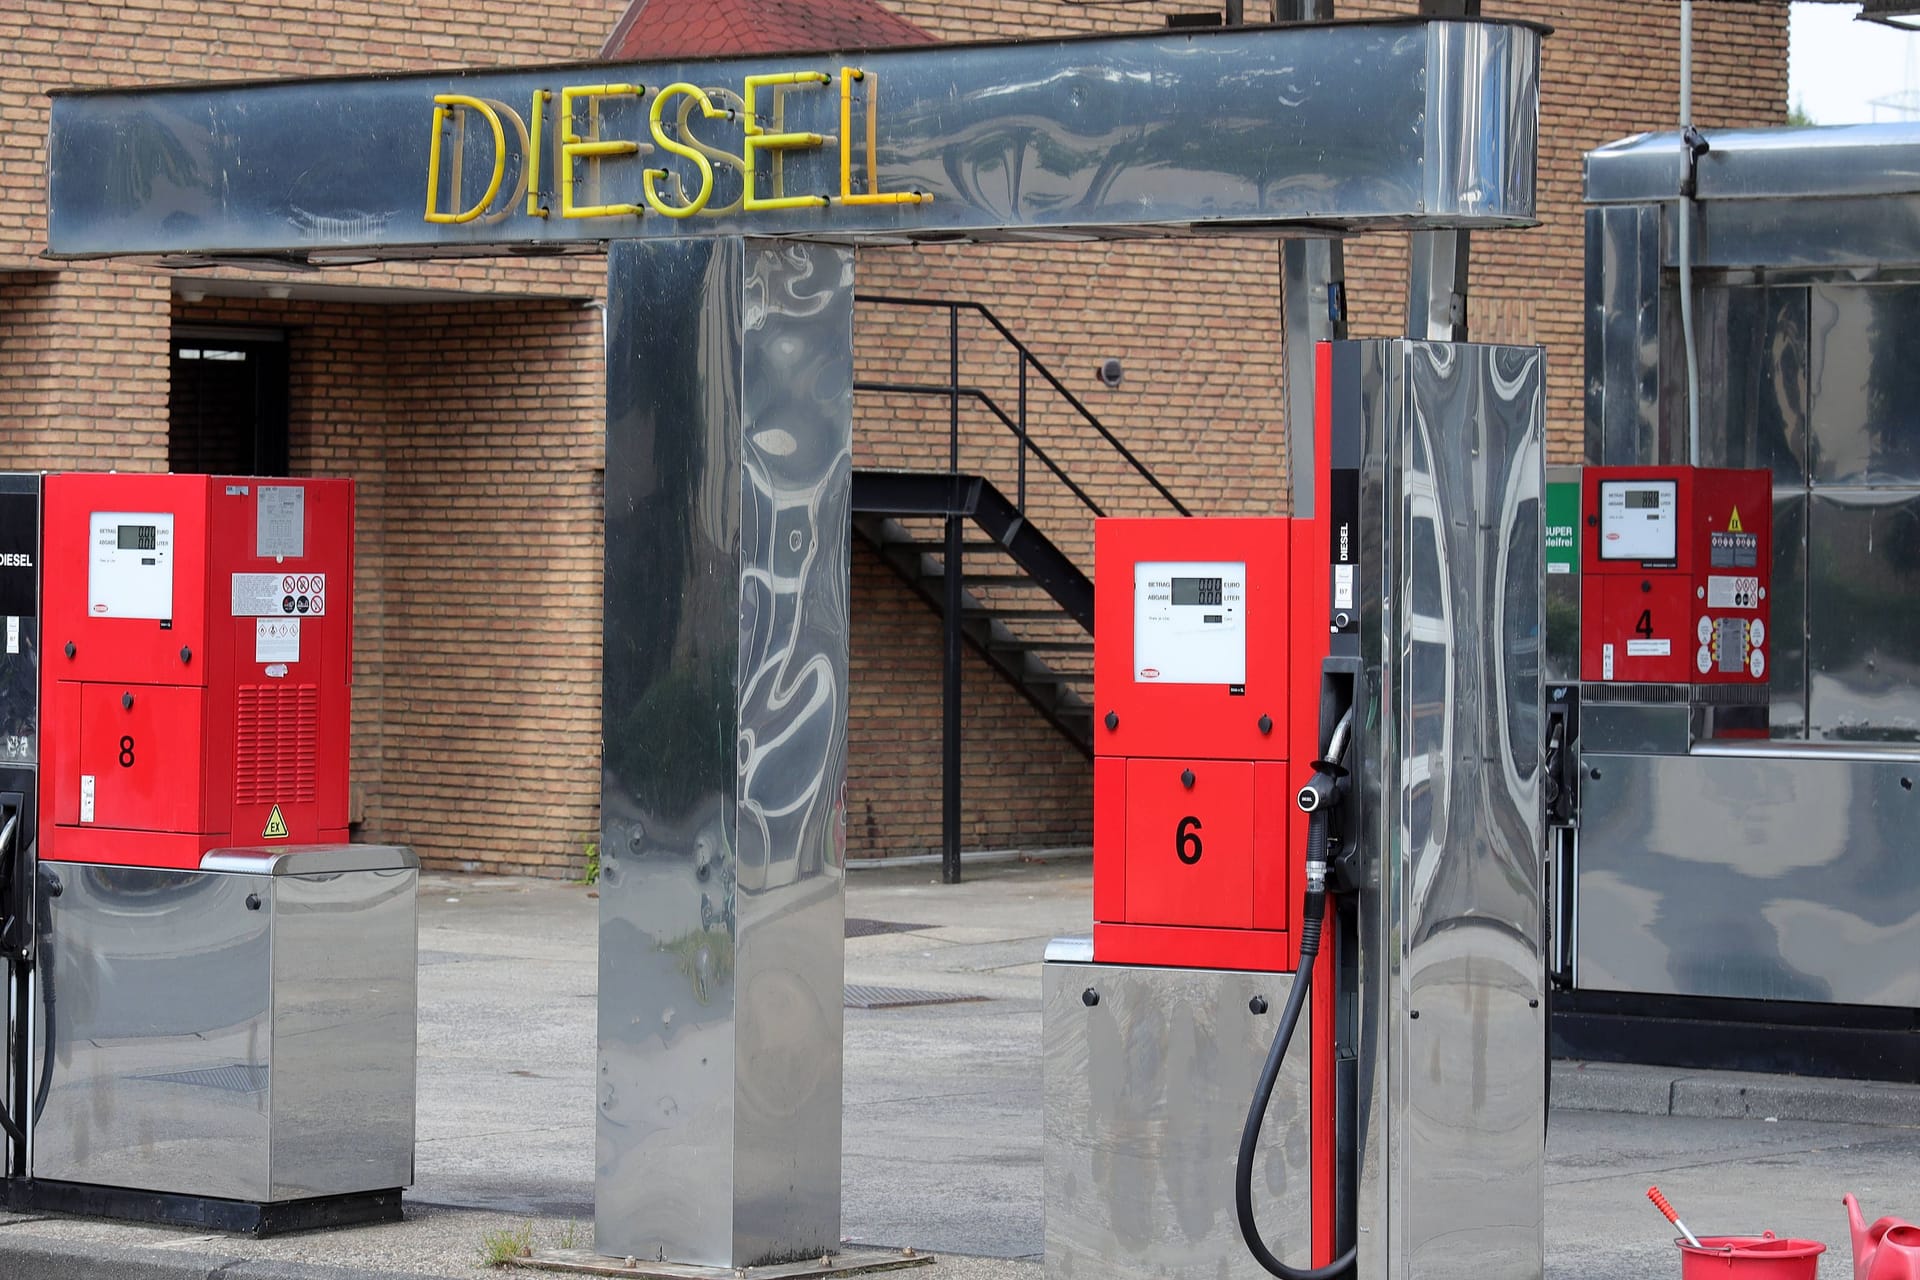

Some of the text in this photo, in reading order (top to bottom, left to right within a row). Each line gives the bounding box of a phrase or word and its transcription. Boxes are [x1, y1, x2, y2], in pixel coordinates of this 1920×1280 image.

[422, 66, 934, 224] DIESEL
[1340, 523, 1348, 561] DIESEL
[1635, 608, 1654, 639] 4
[118, 735, 135, 768] 8
[270, 823, 280, 833] EX
[1176, 816, 1203, 865] 6
